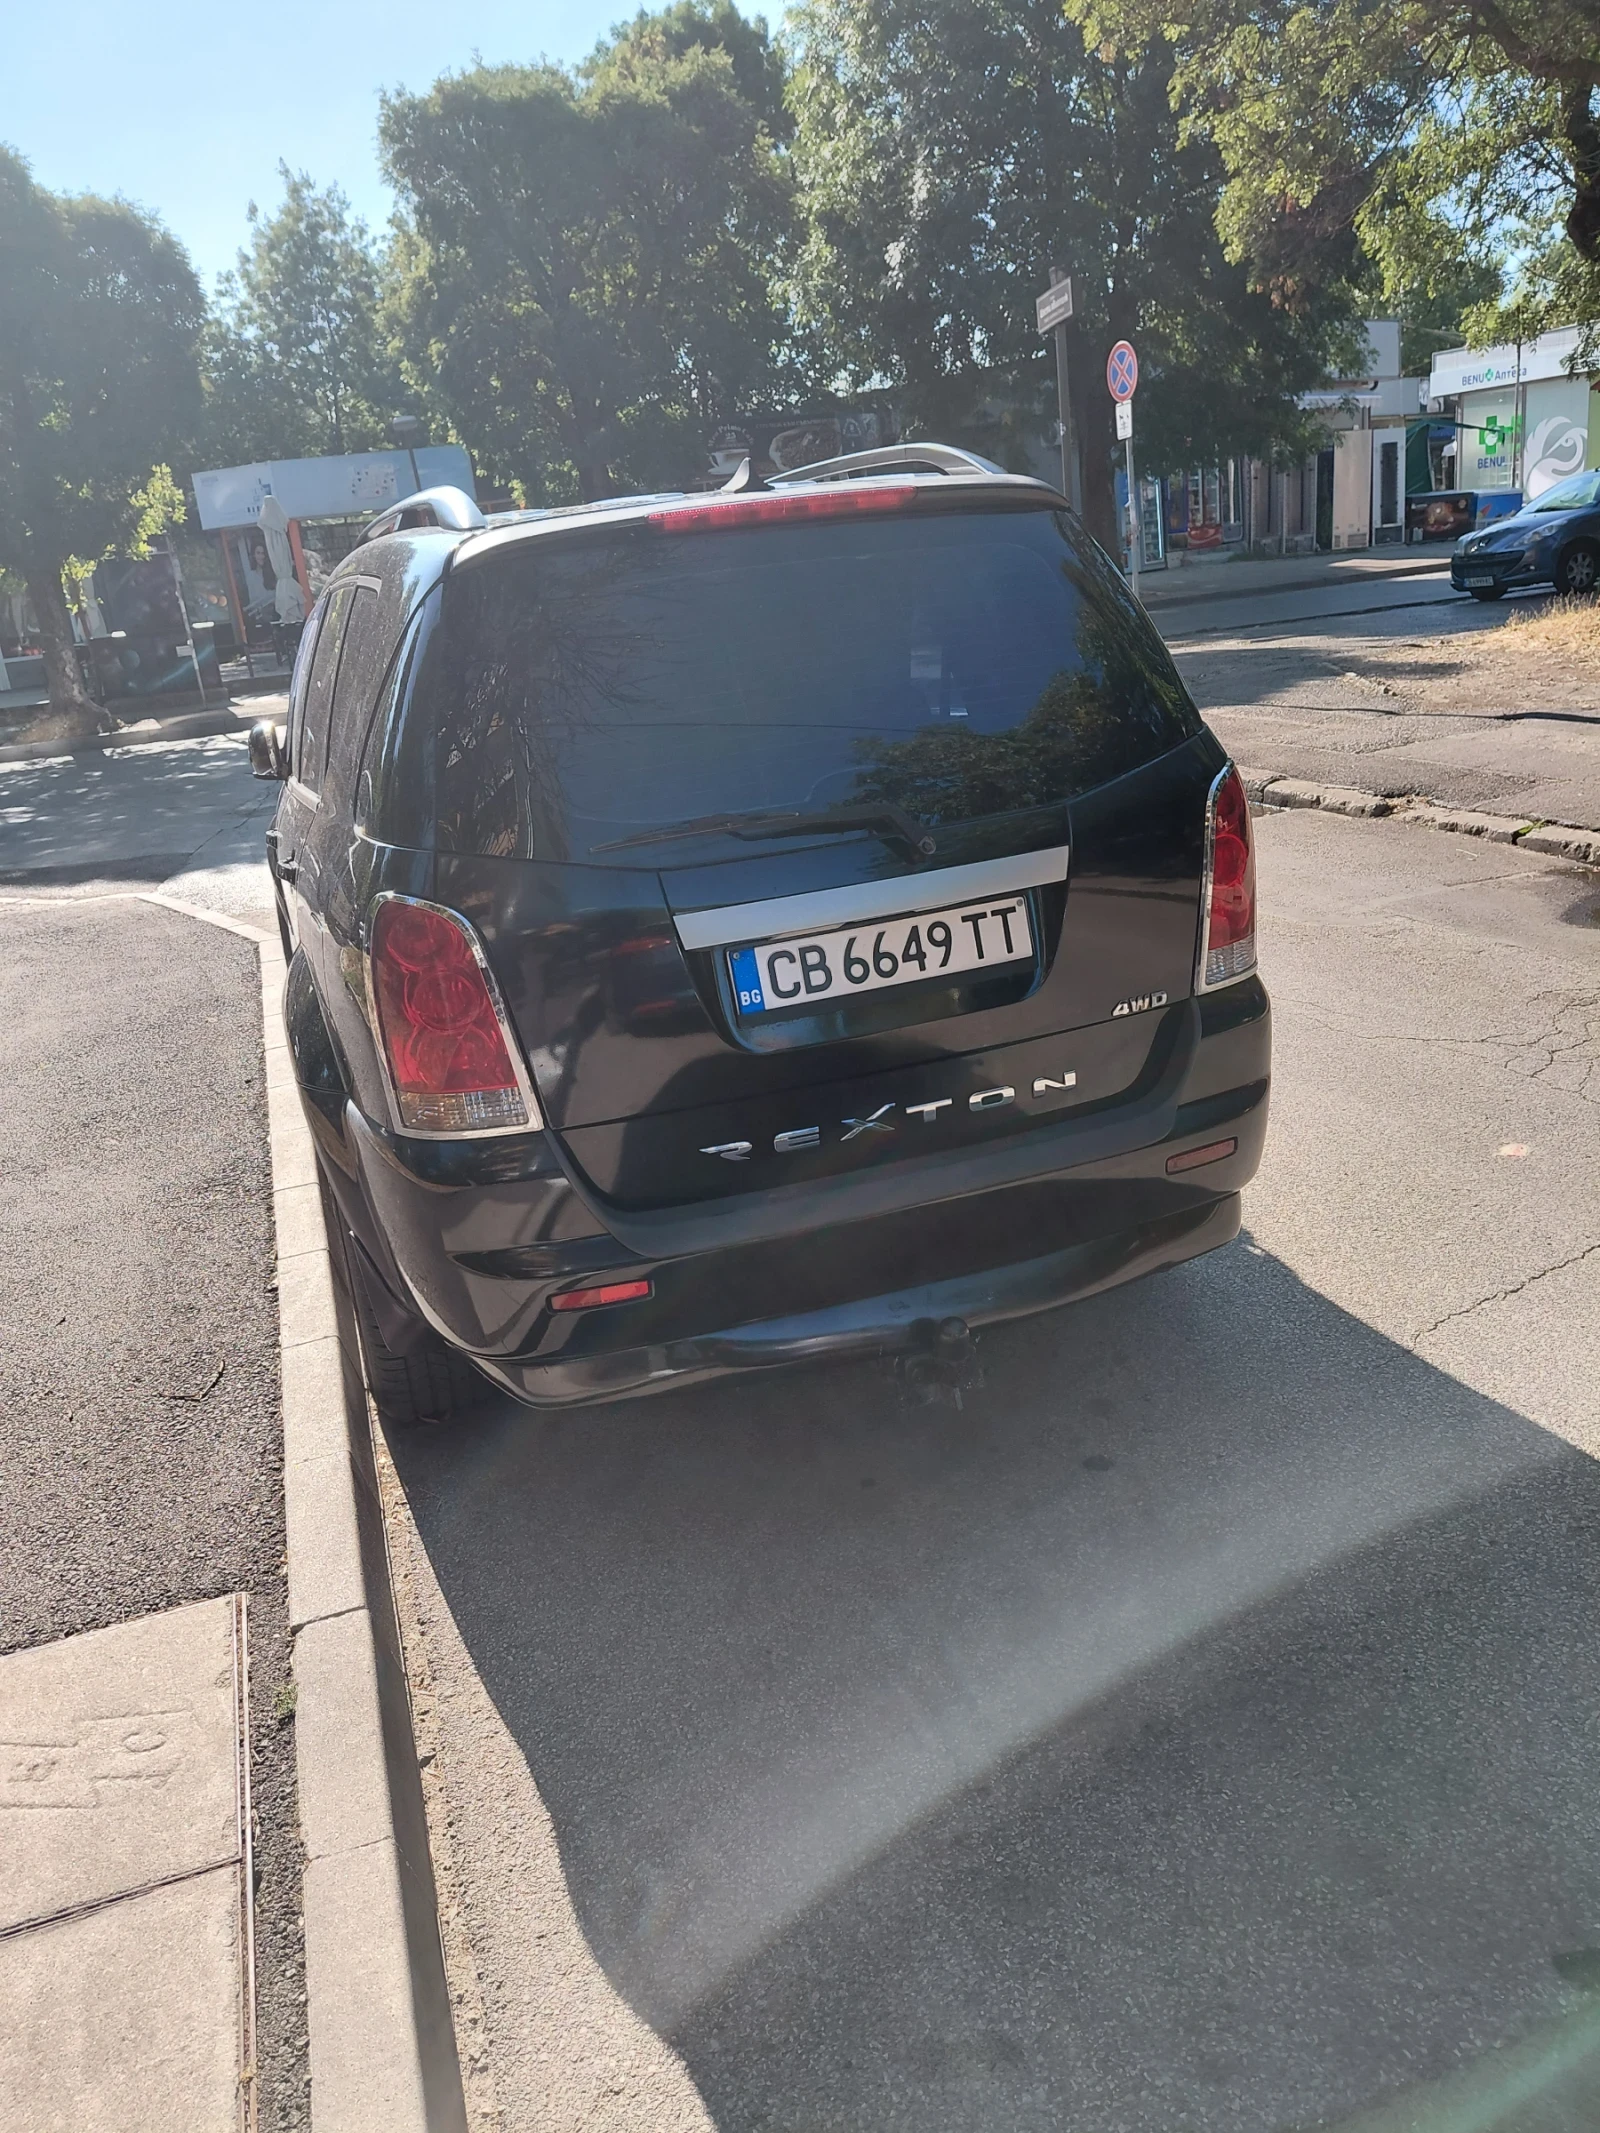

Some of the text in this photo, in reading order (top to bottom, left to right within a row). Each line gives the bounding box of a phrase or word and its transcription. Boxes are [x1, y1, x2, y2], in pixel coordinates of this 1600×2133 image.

[1462, 375, 1485, 386] BENU
[767, 906, 1017, 998] CB 6649 TT
[741, 989, 762, 1006] BG
[1112, 990, 1168, 1017] 4WD
[699, 1069, 1077, 1162] REXTON
